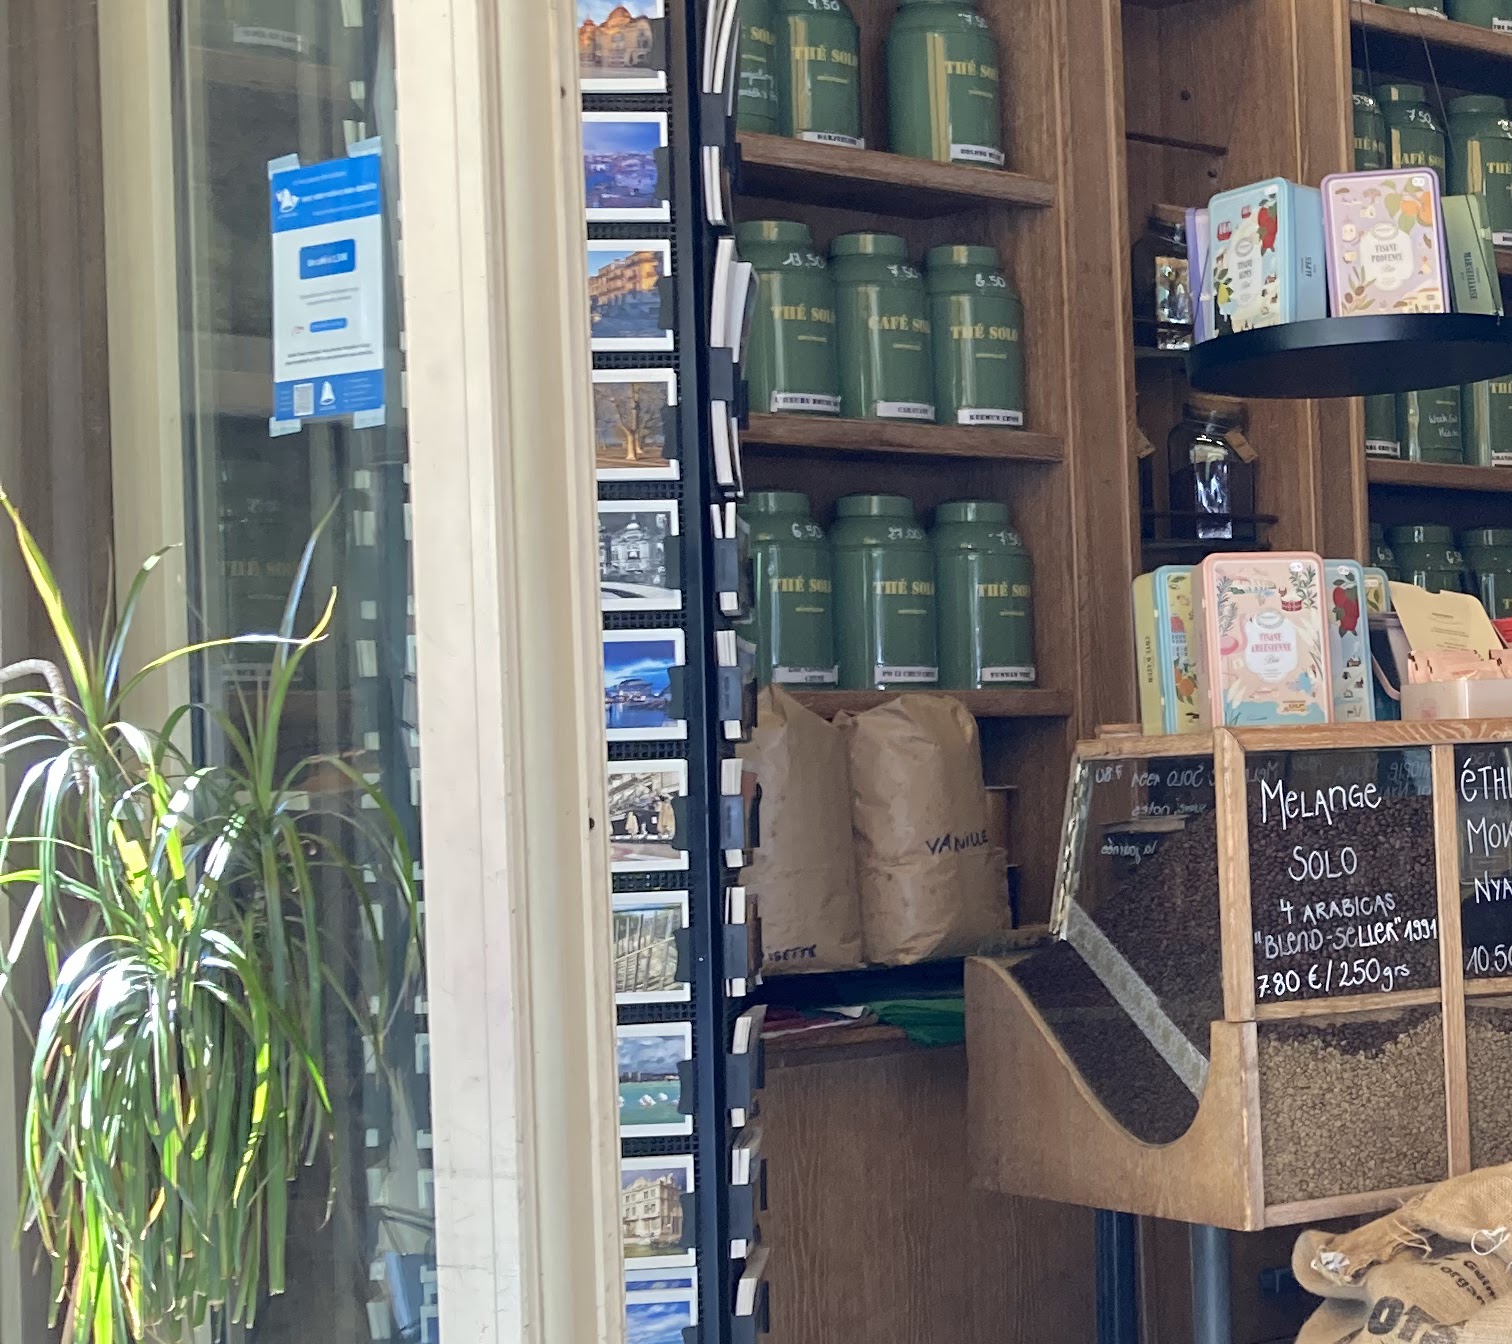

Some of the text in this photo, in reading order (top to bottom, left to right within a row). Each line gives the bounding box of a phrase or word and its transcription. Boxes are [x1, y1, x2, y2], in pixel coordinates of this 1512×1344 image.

[868, 314, 909, 332] CAFÉ
[950, 321, 986, 341] THÉ
[769, 575, 805, 594] THÉ
[872, 577, 909, 596] THÉ
[977, 579, 1009, 598] THÉ
[925, 829, 990, 856] VANILLE
[1288, 846, 1359, 881] SOLO
[1280, 892, 1396, 926] 4 ARABICAS
[1403, 917, 1438, 941] 1991
